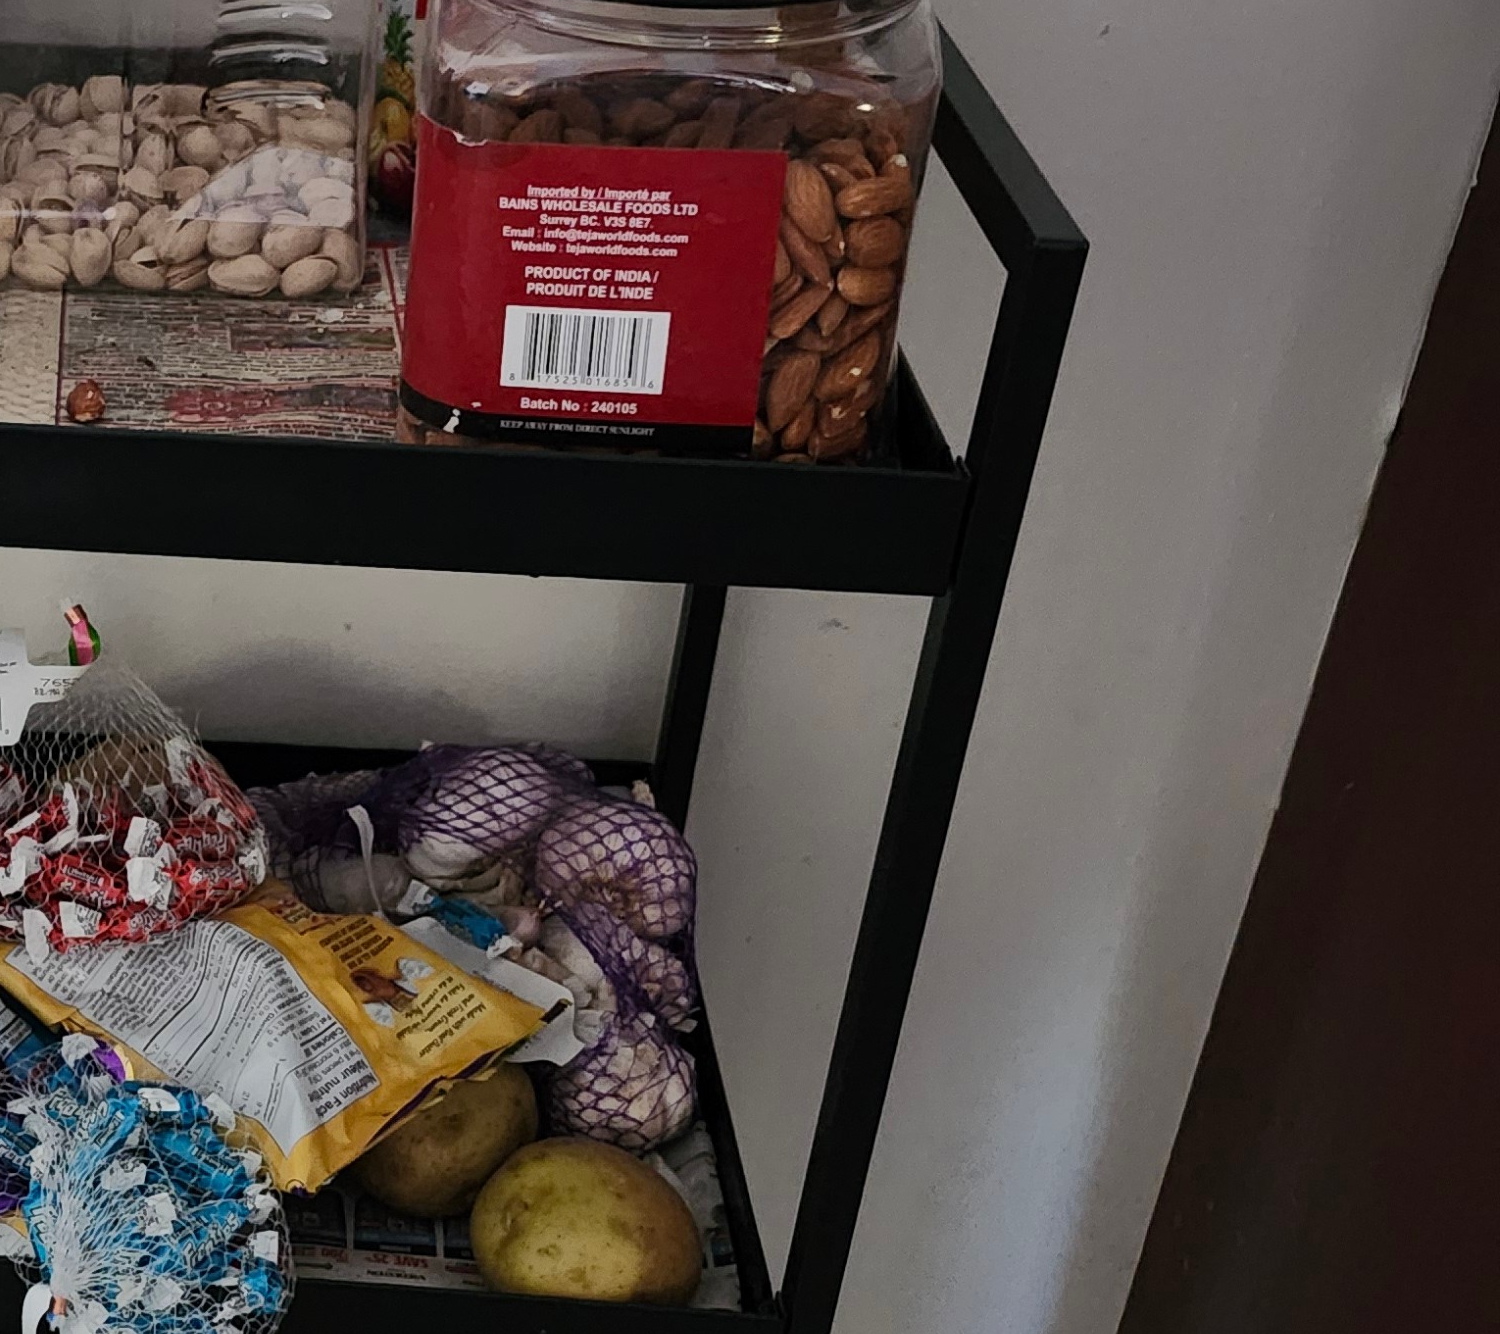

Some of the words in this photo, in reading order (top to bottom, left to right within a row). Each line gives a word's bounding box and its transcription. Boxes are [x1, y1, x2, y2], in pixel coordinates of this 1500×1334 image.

[527, 184, 579, 199] Imported
[581, 186, 596, 200] by
[604, 187, 649, 201] Importé
[650, 189, 672, 202] par
[499, 196, 539, 211] BAINS
[541, 199, 622, 213] WHOLESALE
[624, 202, 671, 215] FOODS
[673, 203, 699, 216] LTD
[539, 214, 578, 228] Surrey
[604, 216, 627, 227] V3S
[502, 225, 535, 238] Email
[544, 227, 689, 244] info@tejaworldfoods.com
[511, 240, 557, 252] Website
[565, 242, 678, 257] tejaworldfoods.com
[524, 265, 591, 281] PRODUCT
[592, 268, 613, 282] OF
[614, 269, 651, 283] INDIA
[526, 282, 586, 297] PRODUIT
[588, 284, 607, 298] DE
[609, 285, 654, 300] L'INDE
[508, 372, 516, 381] 8
[648, 380, 654, 389] 6
[520, 397, 558, 411] Batch
[560, 399, 580, 412] No
[590, 400, 638, 415] 240105
[500, 419, 523, 429] KEEP
[524, 421, 548, 431] AWAY
[548, 422, 574, 432] FROM
[575, 423, 608, 434] DIRECT
[608, 425, 656, 437] SUNLIGHT
[446, 1003, 463, 1018] Fresh
[466, 1002, 487, 1020] Made
[451, 1015, 467, 1031] with
[311, 1027, 345, 1051] Calories
[419, 1038, 440, 1058] Butter
